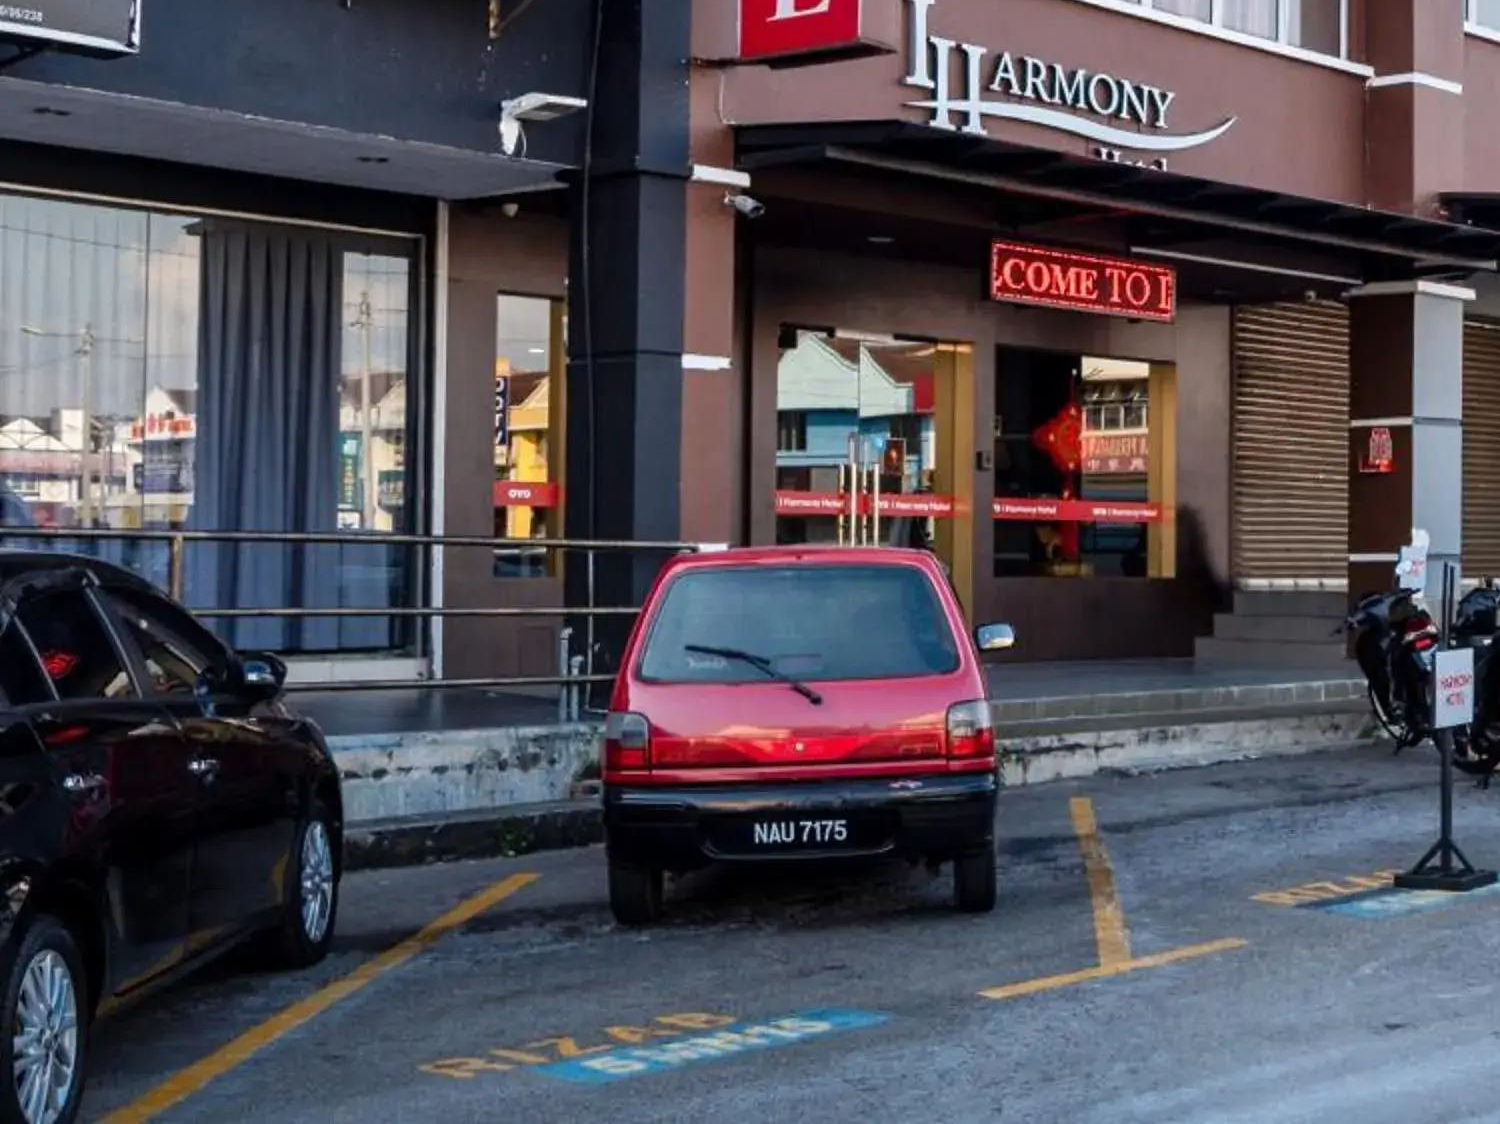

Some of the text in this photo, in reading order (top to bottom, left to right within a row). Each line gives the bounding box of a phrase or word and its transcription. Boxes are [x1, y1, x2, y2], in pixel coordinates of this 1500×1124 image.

[995, 257, 1099, 301] COME
[1104, 267, 1151, 306] TO
[754, 819, 848, 844] NAU 7175
